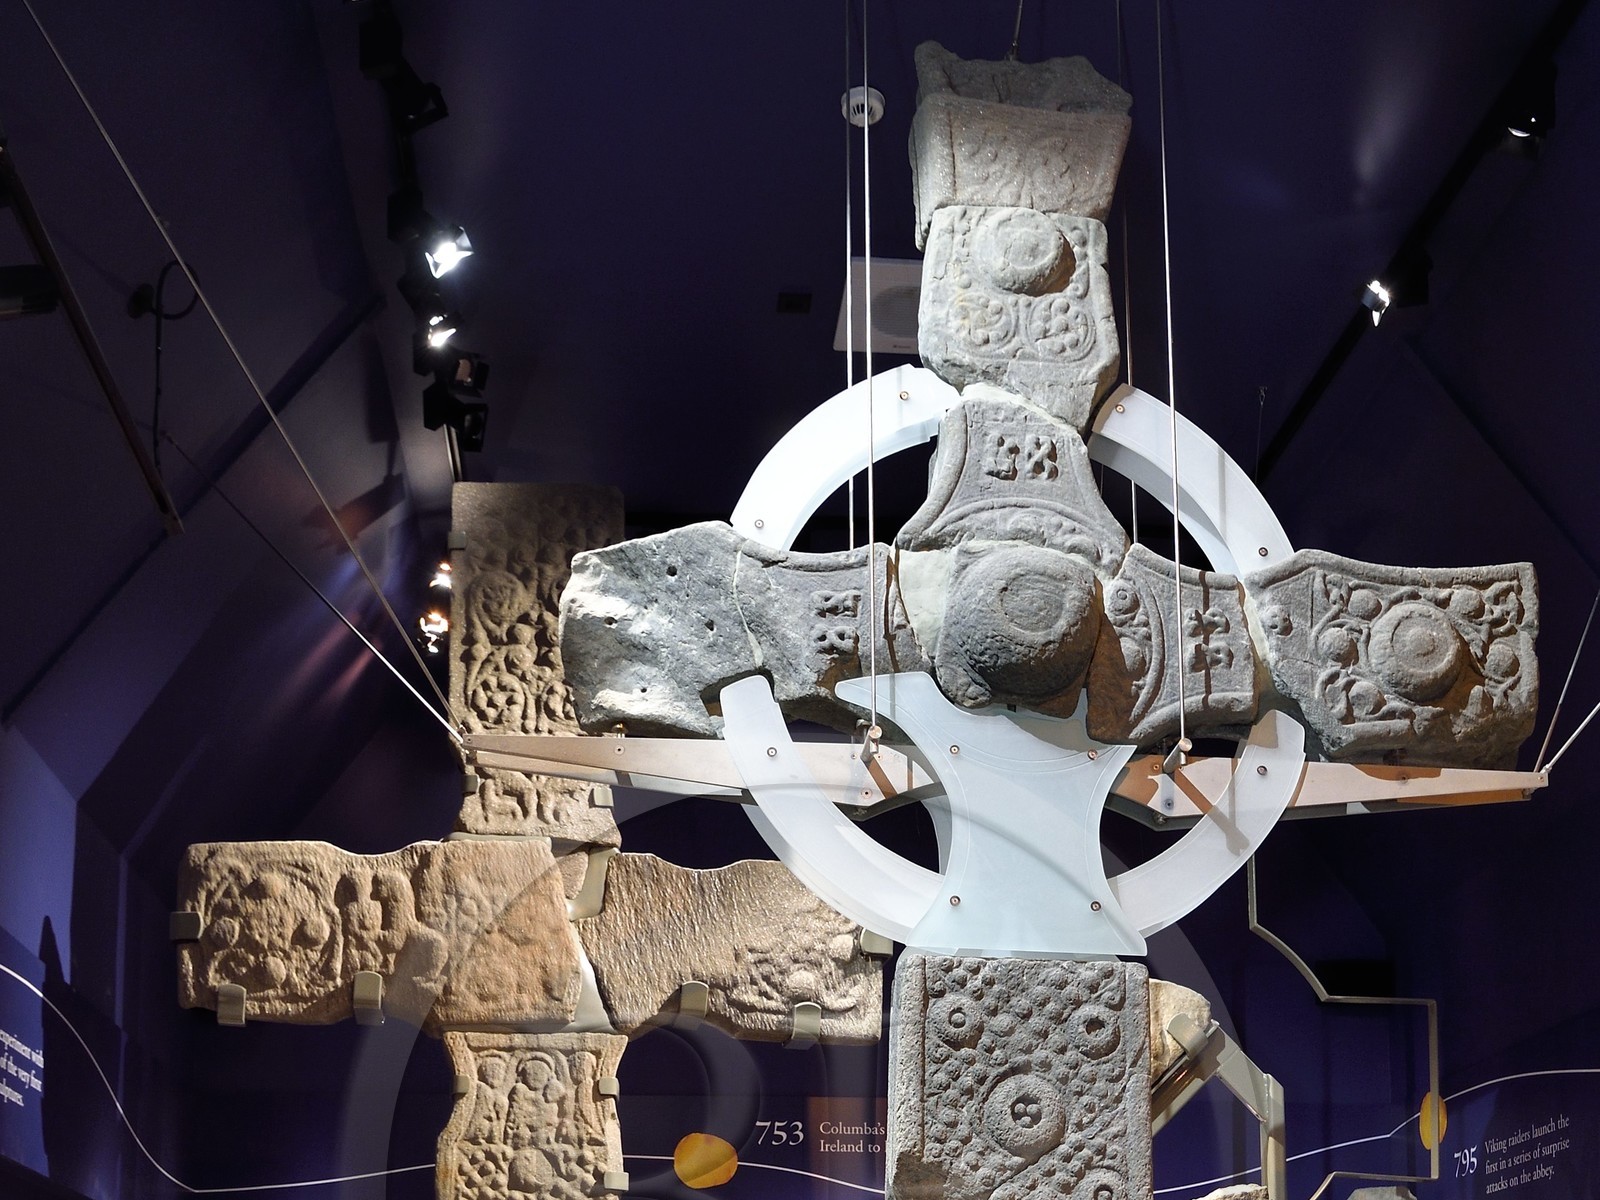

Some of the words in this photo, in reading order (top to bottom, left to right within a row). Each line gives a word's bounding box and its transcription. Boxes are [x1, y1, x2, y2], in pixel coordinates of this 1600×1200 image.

[18, 1068, 30, 1089] very
[755, 1121, 804, 1146] 753
[820, 1121, 885, 1135] Columba's
[1485, 1139, 1507, 1154] Viking
[1508, 1131, 1530, 1147] raiders
[1532, 1118, 1556, 1139] launch
[1558, 1113, 1570, 1130] the
[820, 1140, 863, 1152] Ireland
[868, 1143, 880, 1153] to
[1485, 1160, 1498, 1174] first
[1500, 1158, 1507, 1170] in
[1508, 1159, 1512, 1168] a
[1513, 1150, 1531, 1166] series
[1533, 1143, 1541, 1159] of
[1542, 1137, 1570, 1158] surprise
[1454, 1145, 1477, 1178] 795
[1486, 1176, 1508, 1194] attacks
[1509, 1176, 1519, 1187] on
[1520, 1169, 1531, 1184] the
[1533, 1164, 1555, 1180] abbey.
